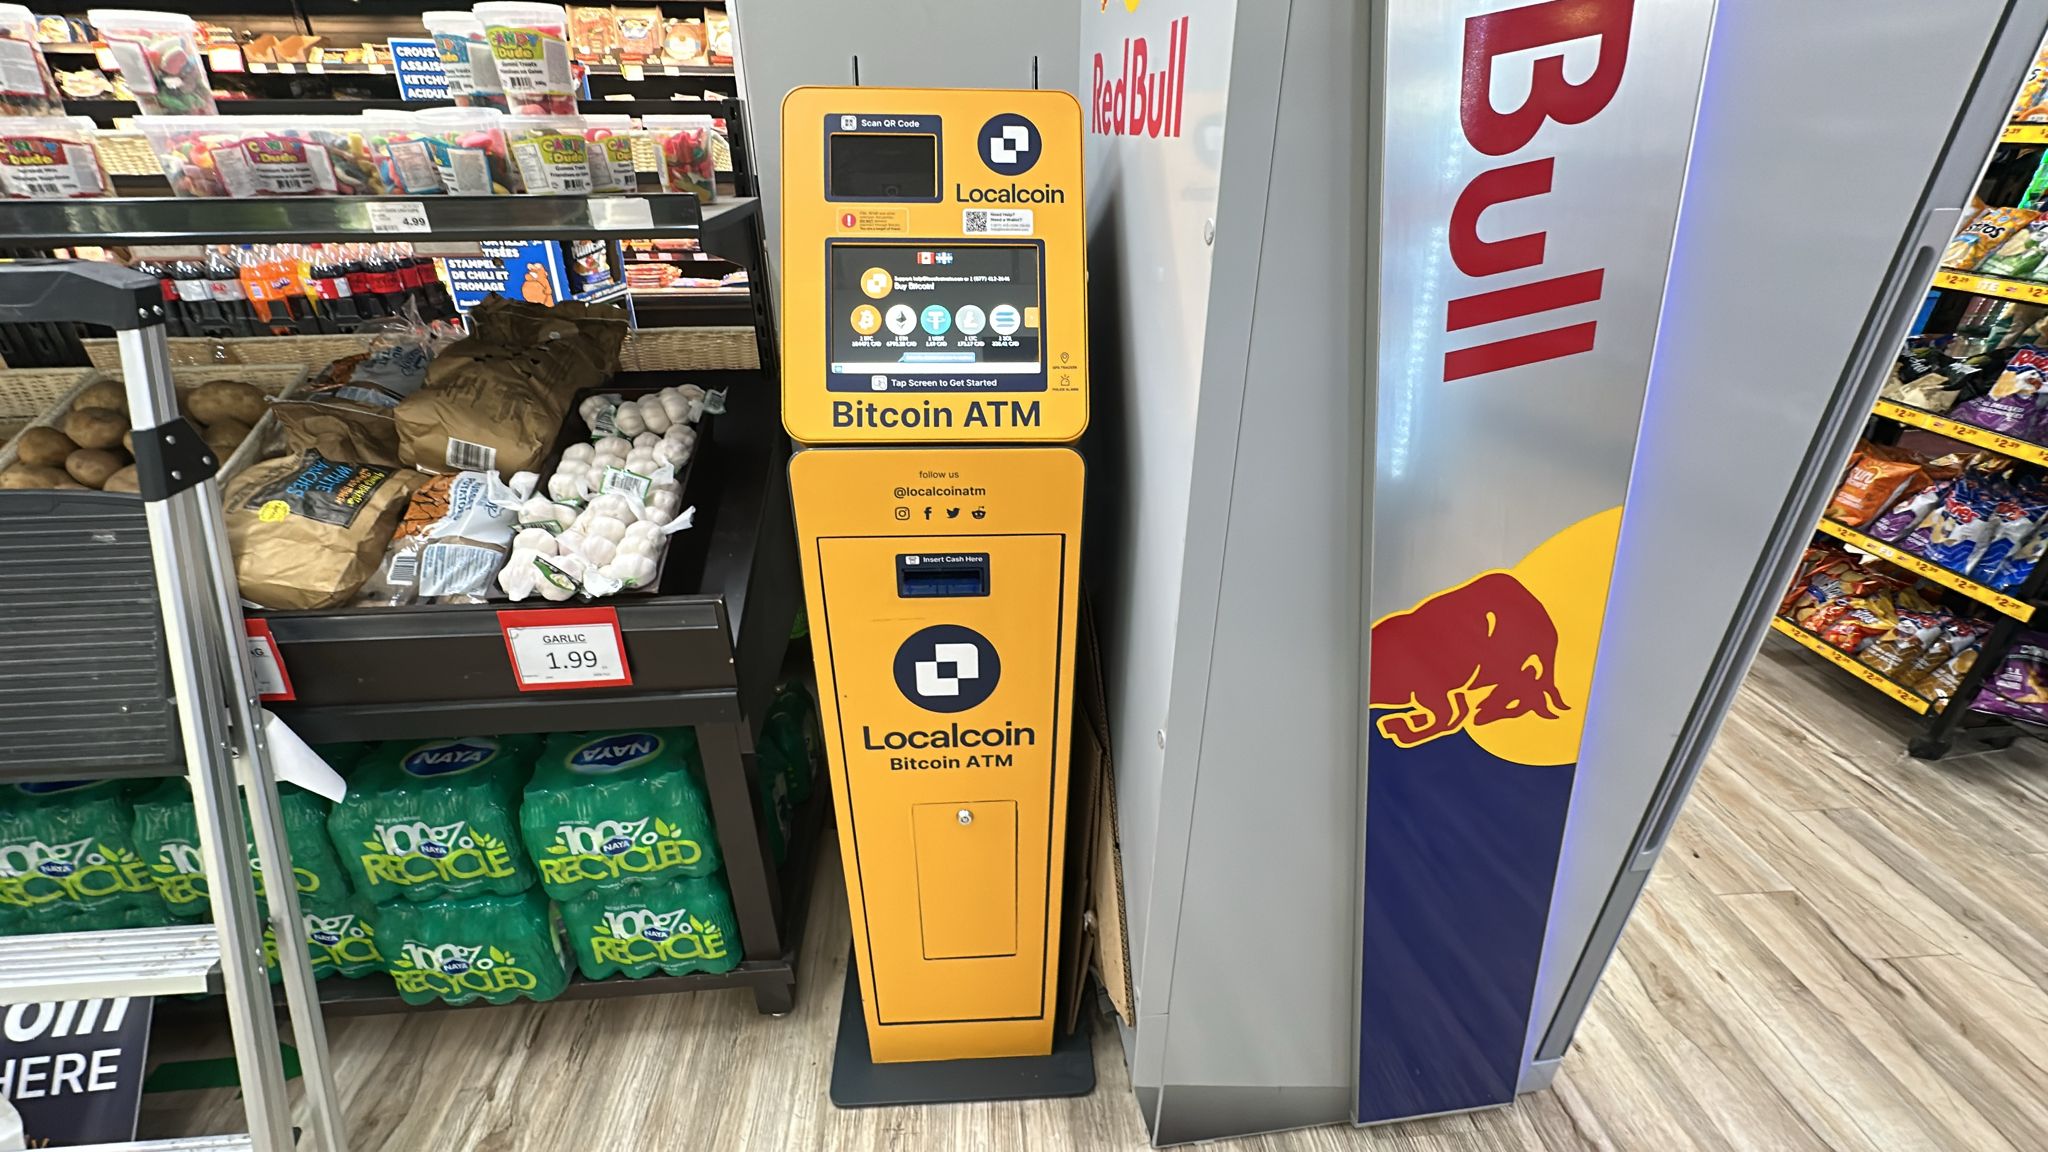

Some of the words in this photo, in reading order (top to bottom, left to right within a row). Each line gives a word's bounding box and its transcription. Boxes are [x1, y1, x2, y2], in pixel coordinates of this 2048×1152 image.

[491, 30, 539, 47] CANDY
[499, 47, 533, 60] Dude
[861, 118, 882, 128] Scan
[883, 118, 896, 129] QR
[897, 118, 920, 129] Code
[552, 152, 585, 164] Dude
[956, 183, 1065, 204] Localcoin
[1443, 0, 1635, 382] Bull
[402, 217, 426, 226] 4.99
[448, 259, 505, 270] STAMPE
[451, 270, 470, 280] DE
[471, 270, 494, 280] CHILI
[494, 270, 510, 281] ET
[455, 282, 506, 292] FROMAGE
[891, 379, 907, 389] Tap
[908, 379, 937, 388] Screen
[938, 379, 948, 388] to
[949, 378, 965, 388] Get
[967, 378, 998, 388] Started
[832, 400, 953, 428] Bitcoin
[963, 400, 1041, 428] ATM
[316, 464, 353, 494] WHITE
[918, 470, 946, 479] follow
[948, 471, 960, 479] us
[893, 486, 986, 499] @localcoinatm
[965, 555, 983, 563] Here
[543, 633, 586, 644] GARLIC
[546, 650, 598, 670] 1.99
[862, 721, 1035, 751] Localcoin
[413, 750, 484, 765] NAYA
[581, 741, 650, 762] NAYA
[890, 756, 960, 771] Bitcoin
[966, 754, 1014, 768] ATM
[374, 820, 475, 857] 100%
[556, 816, 659, 856] 100%
[420, 845, 448, 855] NAYA
[602, 840, 630, 853] NAYA
[539, 839, 703, 885] RECYCLED
[604, 908, 693, 940] 100%
[644, 930, 668, 938] NAYA
[402, 943, 494, 973] 100%
[444, 963, 469, 972] NAYA
[389, 966, 537, 995] RECYCLED
